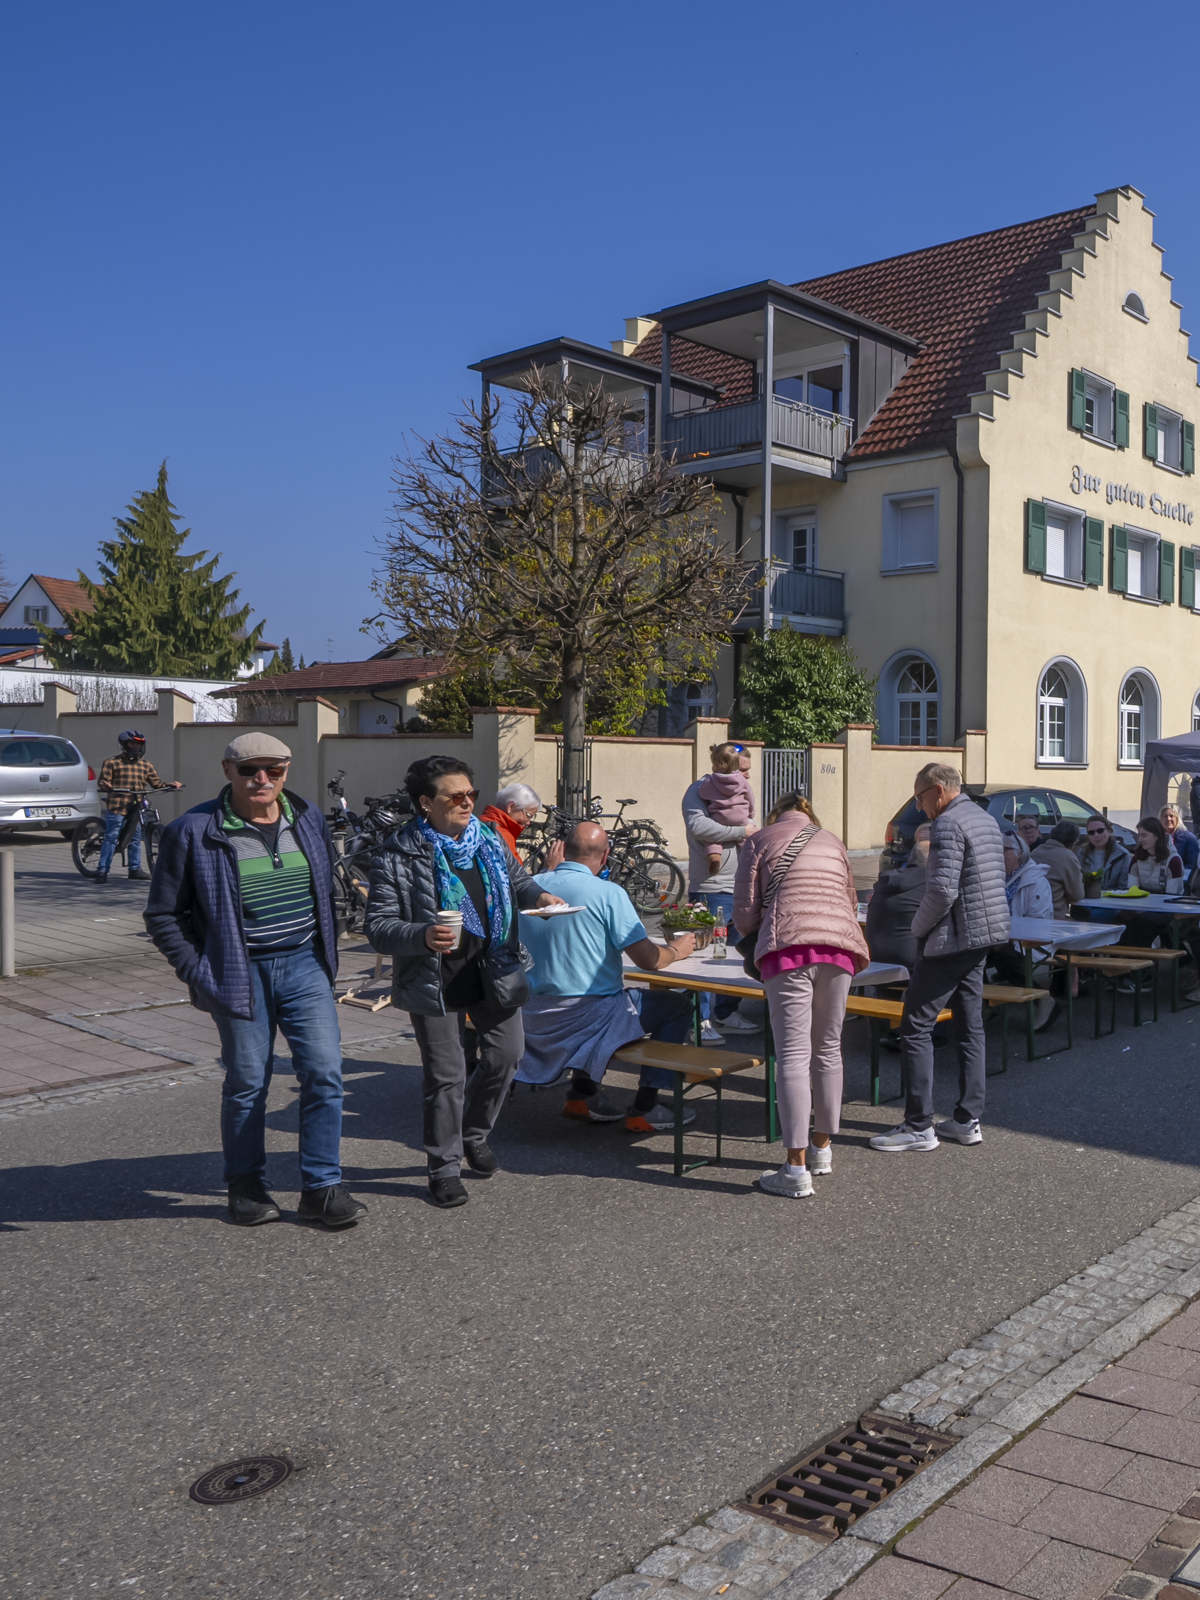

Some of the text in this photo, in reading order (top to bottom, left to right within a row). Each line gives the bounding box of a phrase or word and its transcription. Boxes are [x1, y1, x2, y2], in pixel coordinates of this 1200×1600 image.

[1069, 464, 1195, 525] Zur guten Quelle
[820, 763, 836, 775] 80a
